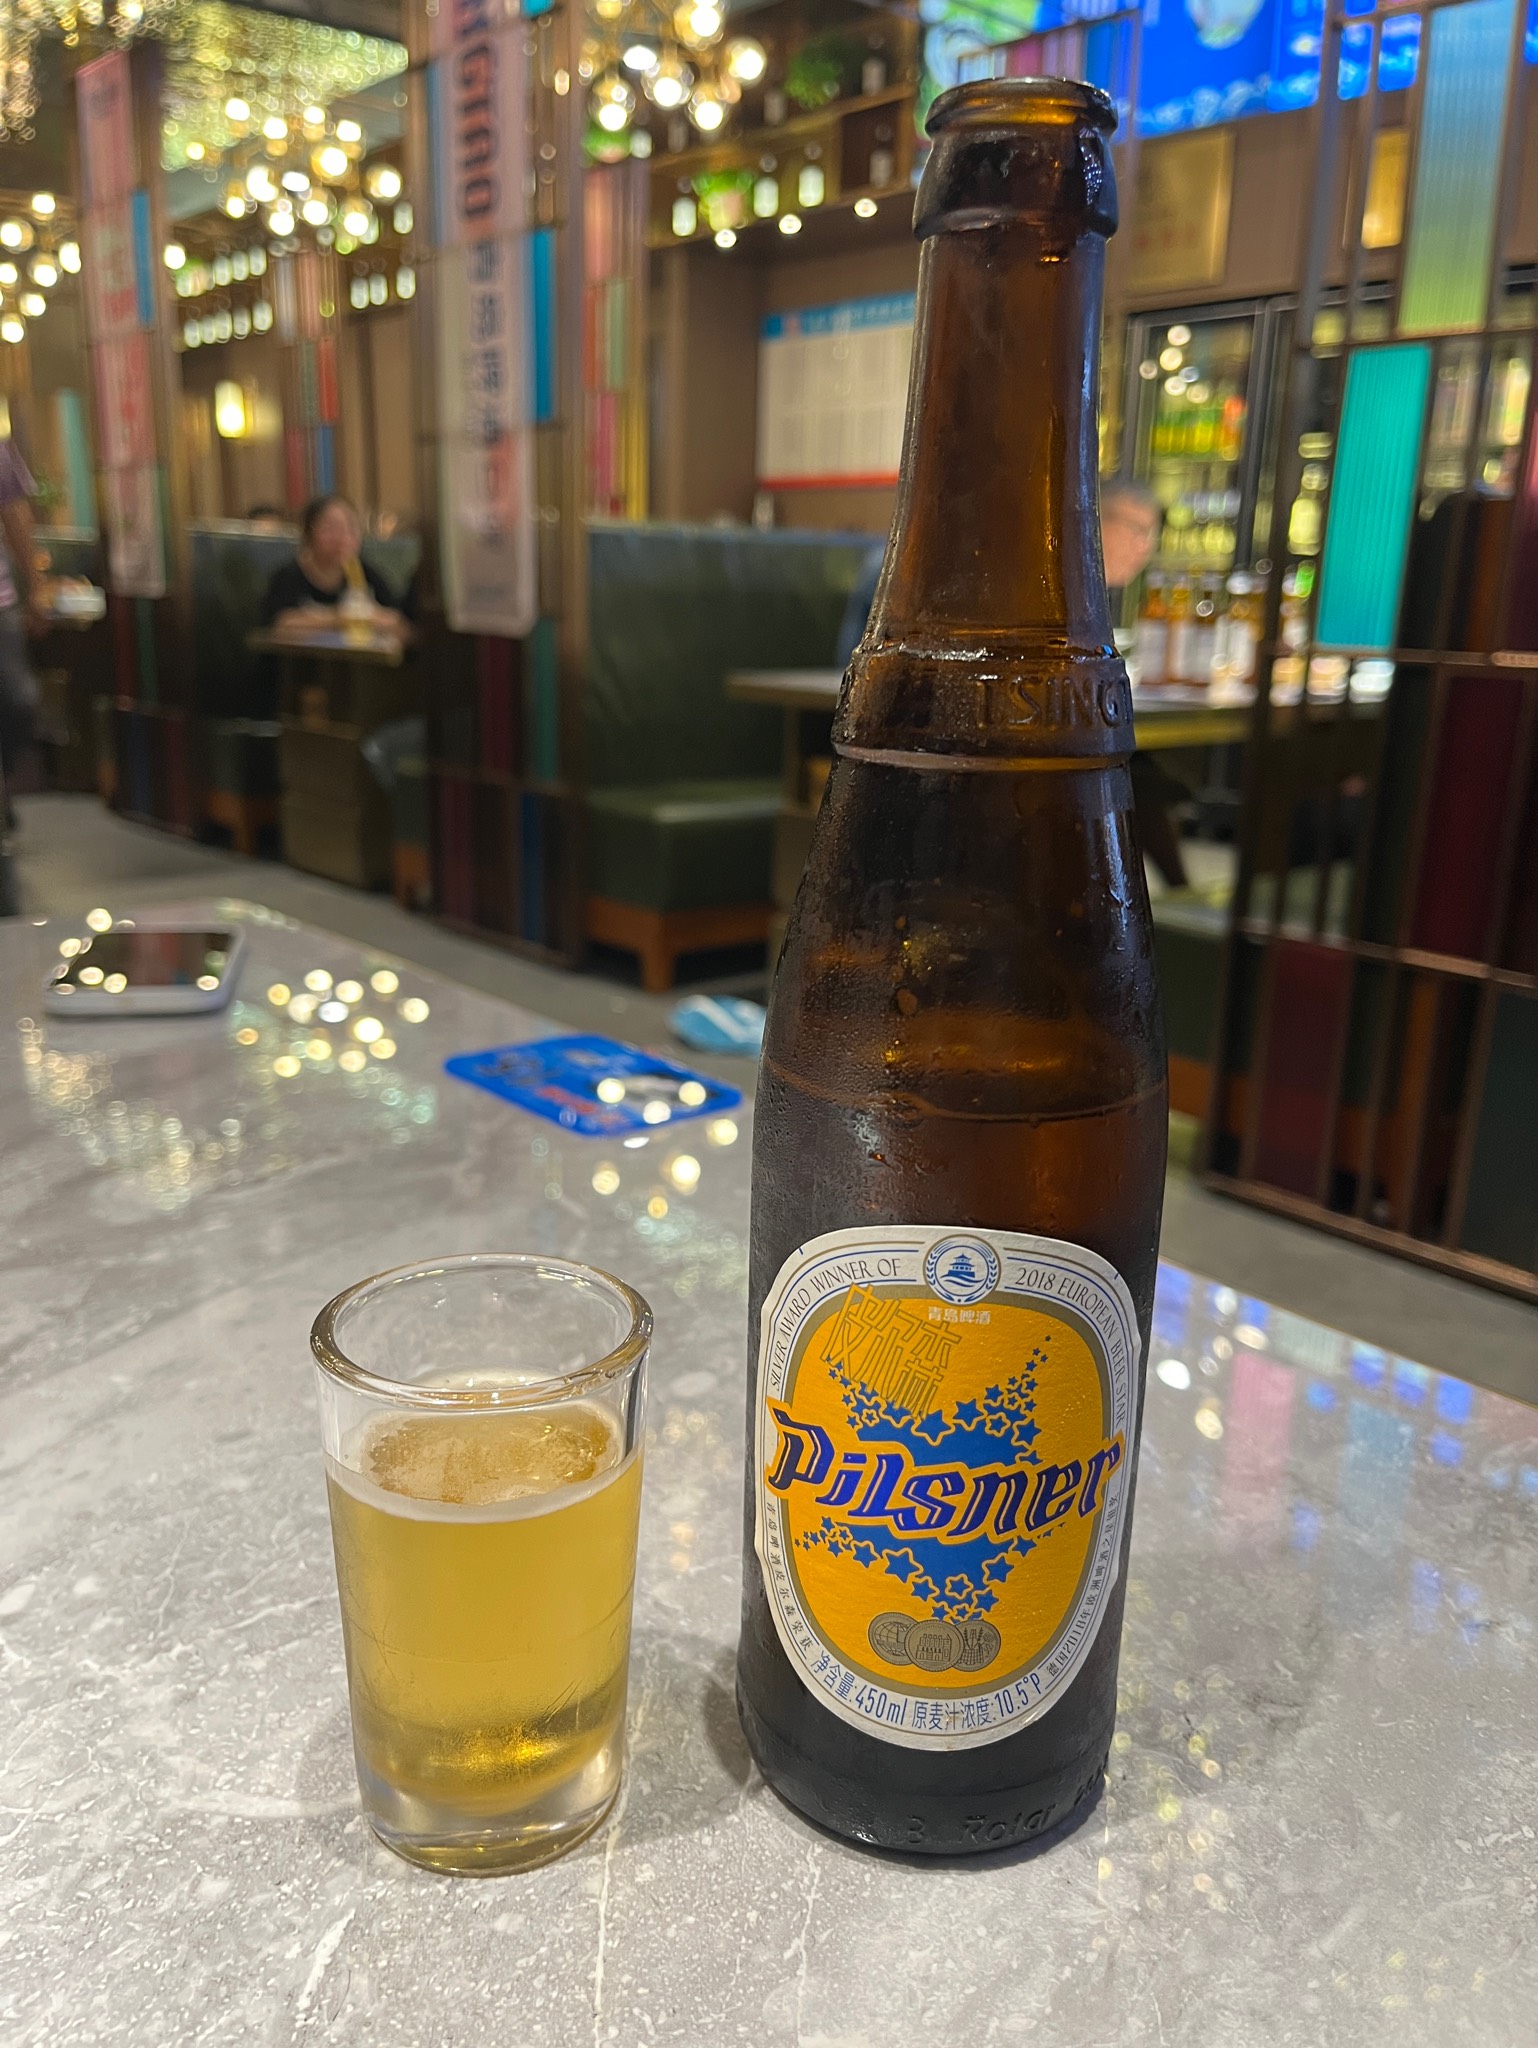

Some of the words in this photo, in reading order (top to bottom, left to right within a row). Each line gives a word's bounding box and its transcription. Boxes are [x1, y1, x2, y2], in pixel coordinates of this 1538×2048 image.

[1015, 1267, 1056, 1291] 2018
[770, 1340, 788, 1391] SILVER
[779, 1288, 812, 1342] AWARD
[810, 1260, 874, 1293] WINNER
[877, 1258, 902, 1277] OF
[928, 1306, 991, 1325] 青岛啤酒
[1057, 1277, 1119, 1340] EUROPEAN
[1110, 1338, 1127, 1383] BEER
[1115, 1383, 1127, 1427] STAR
[767, 1406, 1122, 1537] Pilsner
